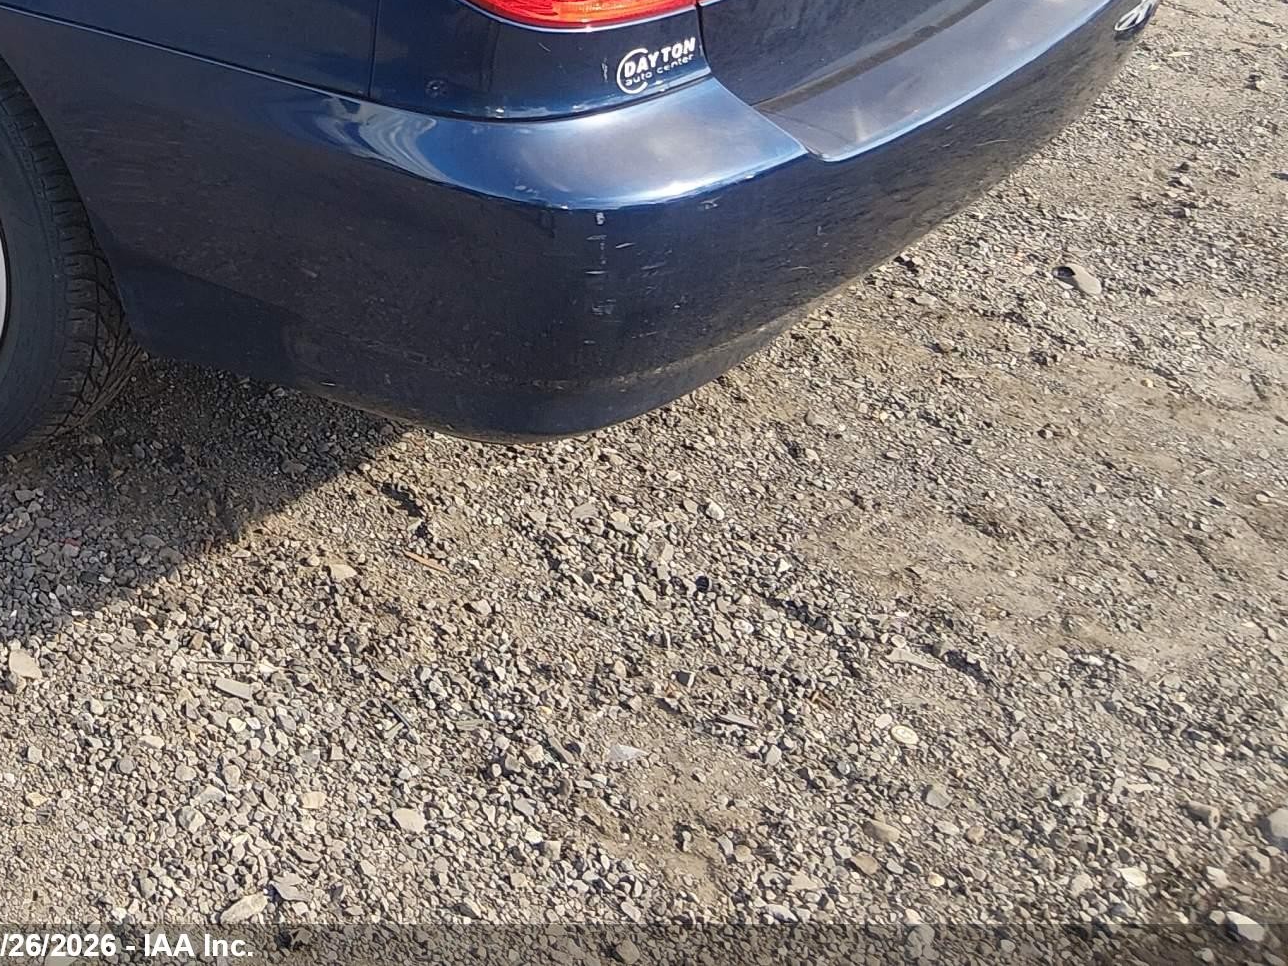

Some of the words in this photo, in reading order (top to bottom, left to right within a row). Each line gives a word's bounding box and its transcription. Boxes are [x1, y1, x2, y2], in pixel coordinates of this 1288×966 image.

[623, 36, 696, 78] DAYTON
[624, 70, 653, 87] auto
[656, 53, 694, 75] center
